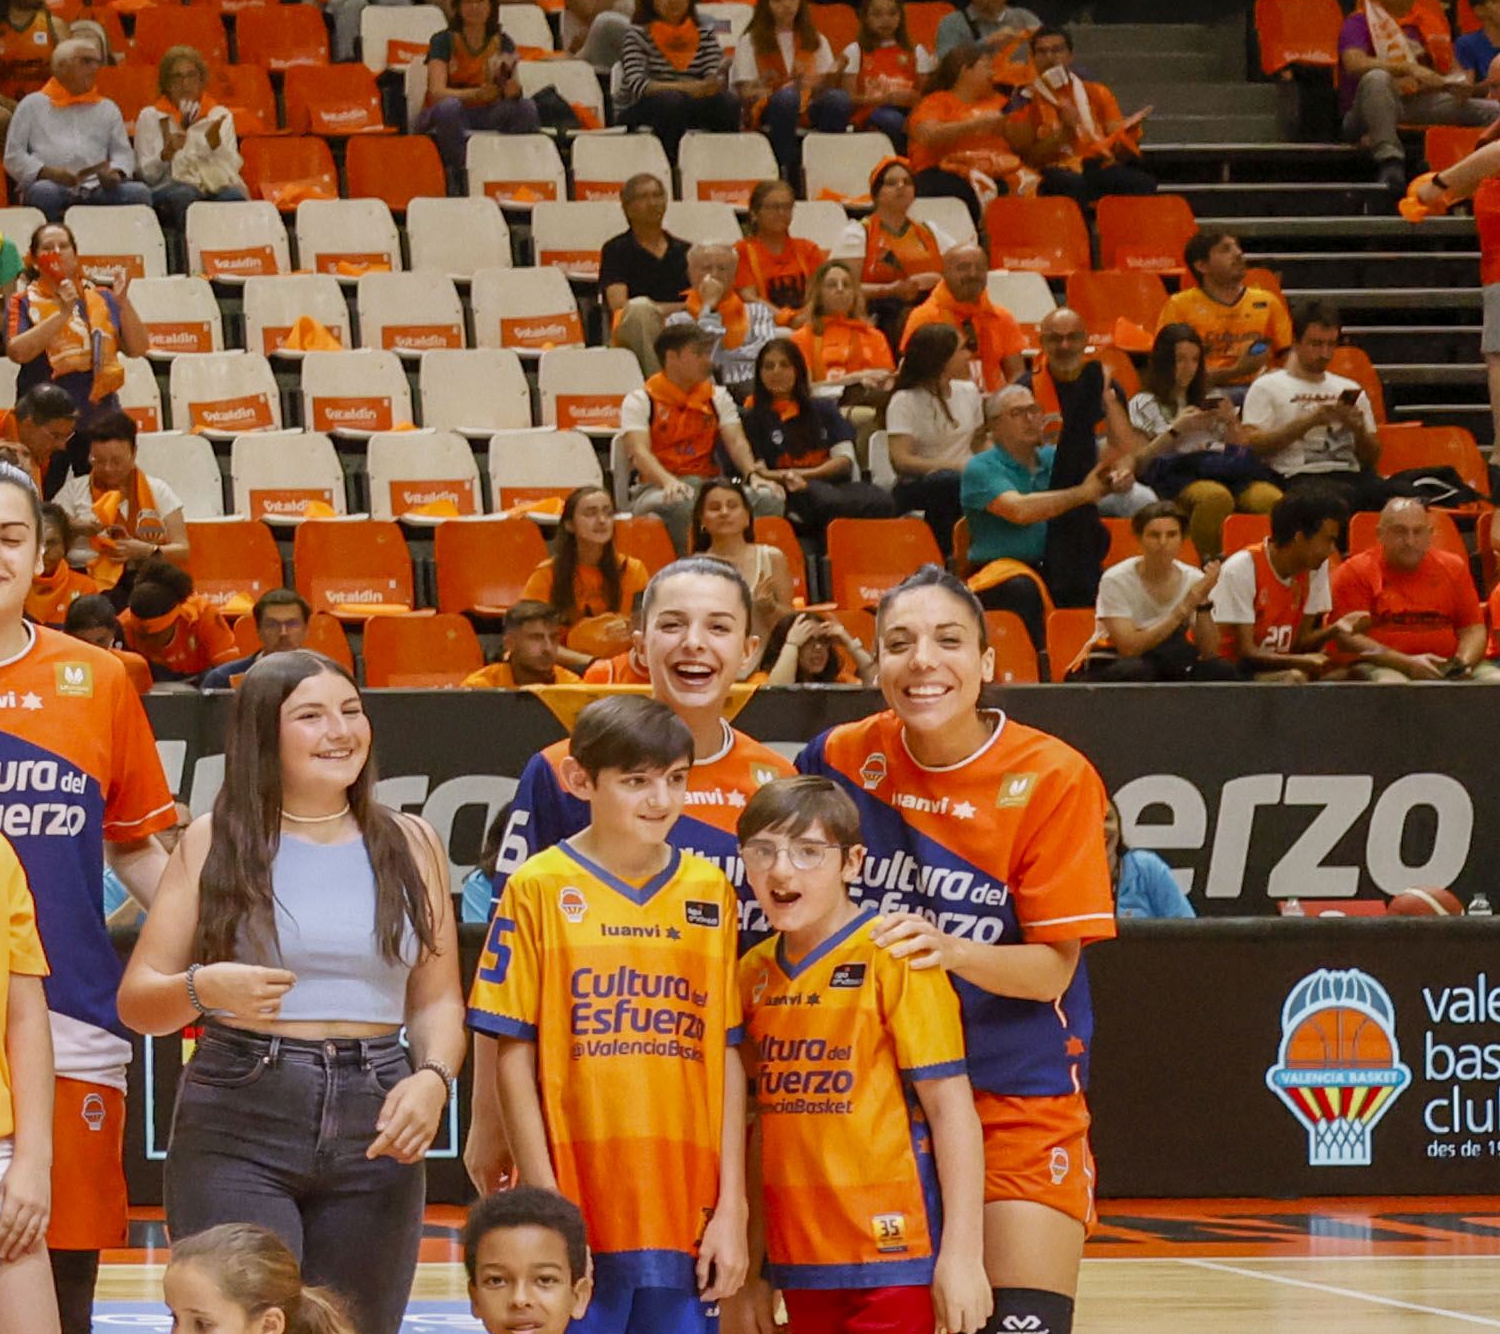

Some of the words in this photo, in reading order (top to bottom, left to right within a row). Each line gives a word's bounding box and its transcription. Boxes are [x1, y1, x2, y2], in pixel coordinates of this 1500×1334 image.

[213, 257, 262, 269] Vitaldin
[393, 335, 448, 348] Vitaldin
[513, 324, 567, 339] Vitaldin
[201, 406, 256, 421] Vitaldin
[324, 407, 377, 420] Vitaldin
[325, 589, 383, 603] Vitaldin
[1263, 624, 1293, 651] 20
[61, 771, 86, 793] del
[685, 791, 724, 805] anvi
[496, 809, 530, 875] 6
[1113, 773, 1475, 898] erzo
[970, 880, 1008, 907] del
[601, 923, 660, 938] luanvi
[479, 917, 516, 985] 5
[572, 965, 690, 1001] Cultura
[1423, 973, 1500, 1022] vale
[571, 1000, 705, 1040] Esfuerzo
[827, 1044, 851, 1061] del
[1423, 1032, 1500, 1081] bas
[759, 1070, 853, 1094] fuerzo
[1281, 1070, 1345, 1084] VALENCIA
[1349, 1070, 1400, 1084] BASKET
[1423, 1086, 1500, 1135] clu
[1427, 1140, 1456, 1158] des
[1461, 1140, 1481, 1158] de
[1487, 1140, 1500, 1158] 19
